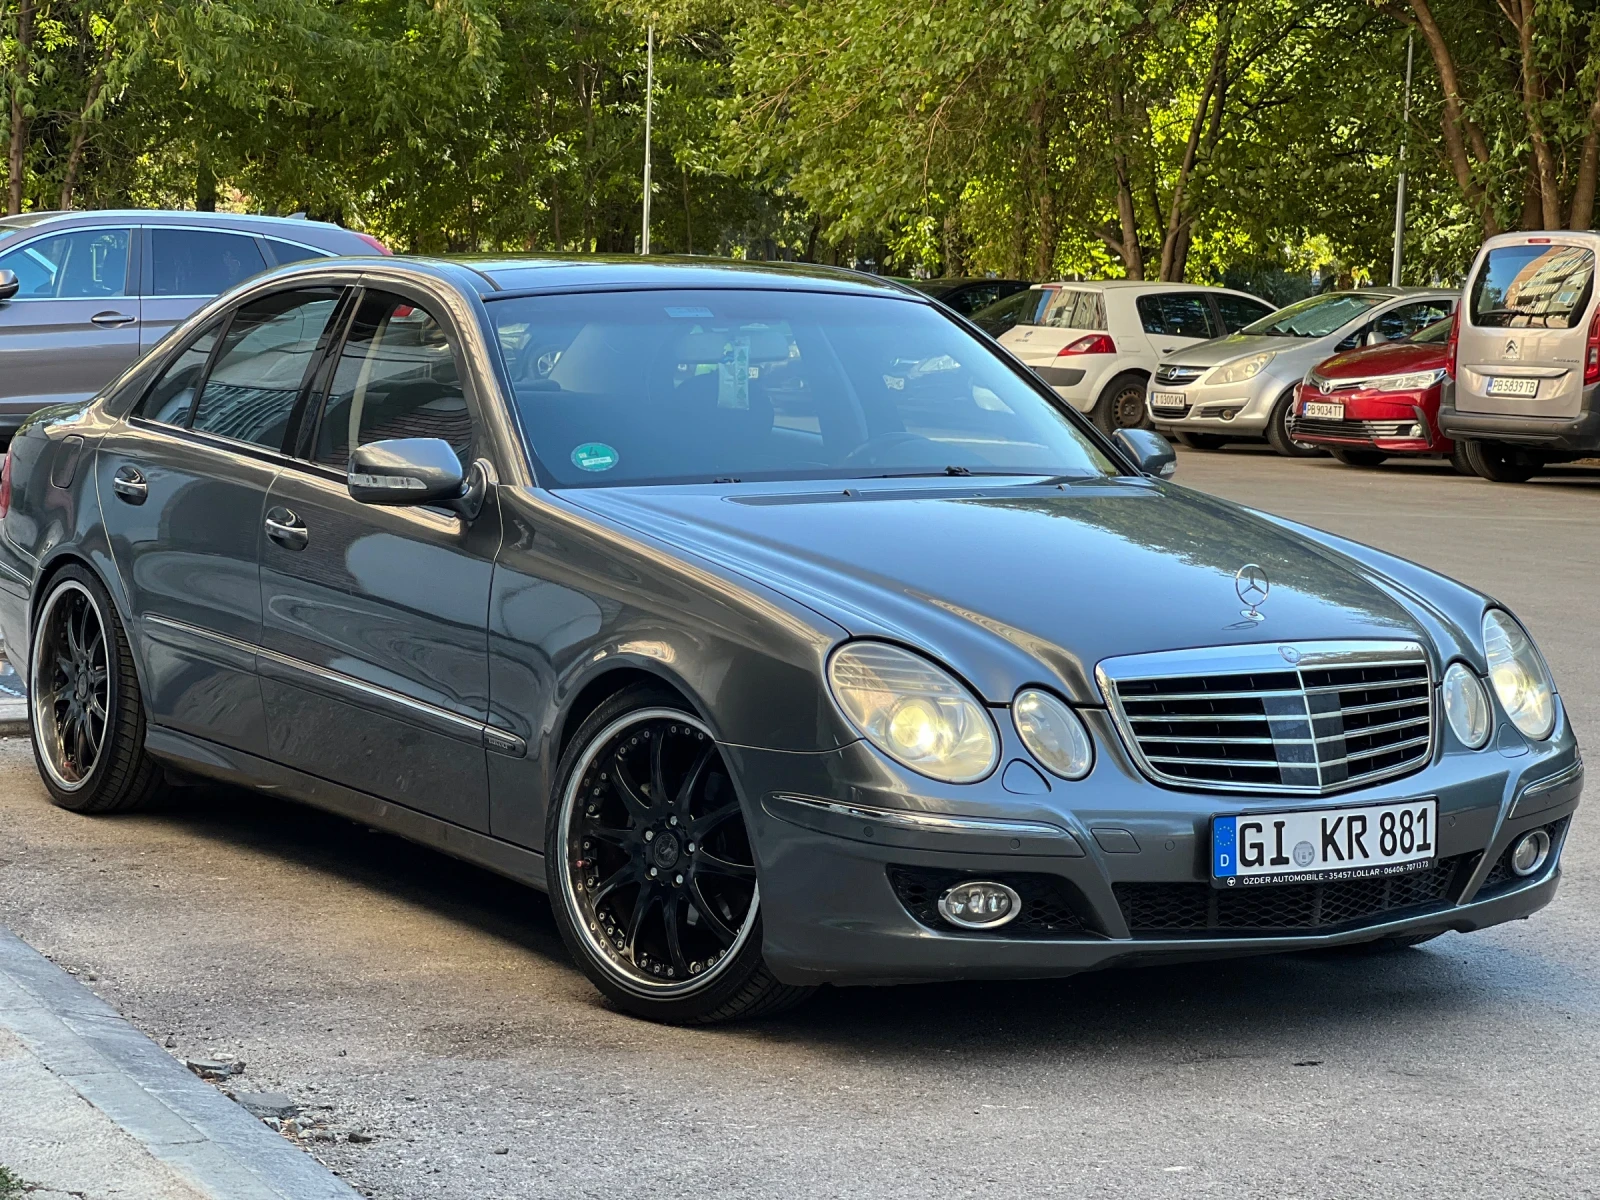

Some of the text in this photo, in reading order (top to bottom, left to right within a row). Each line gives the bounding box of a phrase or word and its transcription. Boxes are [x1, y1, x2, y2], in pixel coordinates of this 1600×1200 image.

[1239, 808, 1431, 867] GI KR 881
[1220, 854, 1230, 867] D
[1243, 876, 1271, 885] ÖZDER
[1329, 871, 1351, 880] 35457
[1352, 869, 1380, 878] LOLLAR
